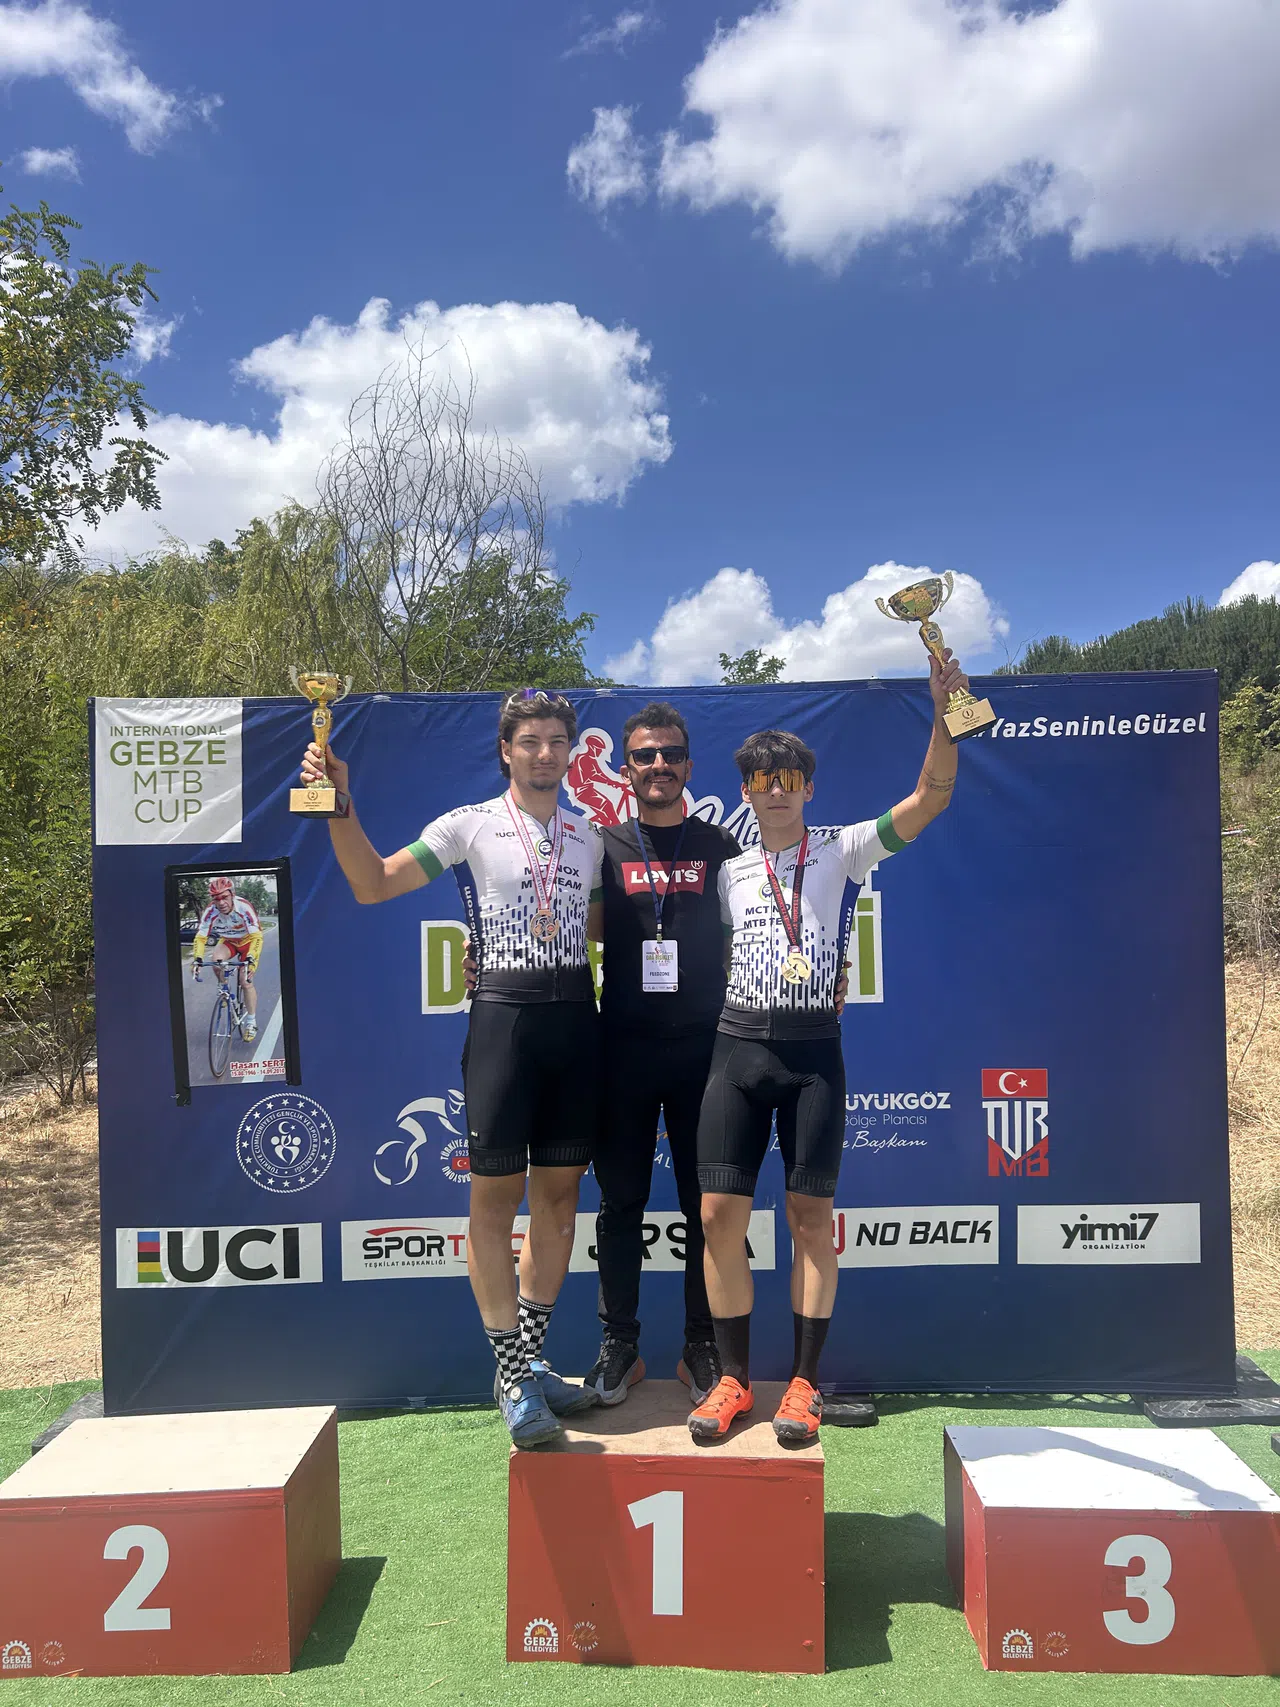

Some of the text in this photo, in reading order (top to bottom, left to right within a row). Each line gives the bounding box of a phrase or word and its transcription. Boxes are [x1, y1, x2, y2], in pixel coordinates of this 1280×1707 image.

[110, 725, 227, 737] INTERNATIONAL
[972, 713, 1207, 738] YazSeninleGüzel
[109, 739, 227, 766] GEBZE
[133, 769, 203, 795] MTB
[134, 798, 203, 824] CUP
[745, 905, 770, 916] MCT
[743, 919, 767, 929] MTB
[231, 1060, 285, 1070] Hasan SERT
[276, 1110, 304, 1120] GENÇLİK
[303, 1117, 311, 1127] VE
[309, 1125, 318, 1142] SPOR
[882, 1113, 928, 1125] Plancısı
[851, 1130, 928, 1154] Başkanı
[856, 1220, 993, 1247] NO BACK
[1060, 1212, 1160, 1249] yirmi7
[167, 1227, 300, 1283] UCI
[401, 1259, 446, 1267] BAŞKANLIĞI
[627, 1490, 684, 1616] 1
[103, 1524, 171, 1632] 2
[1102, 1534, 1176, 1645] 3
[523, 1636, 559, 1646] GEBZE
[523, 1645, 559, 1653] BELEDİYESİ
[1002, 1645, 1034, 1653] GEBZE
[2, 1655, 32, 1664] GEBZE
